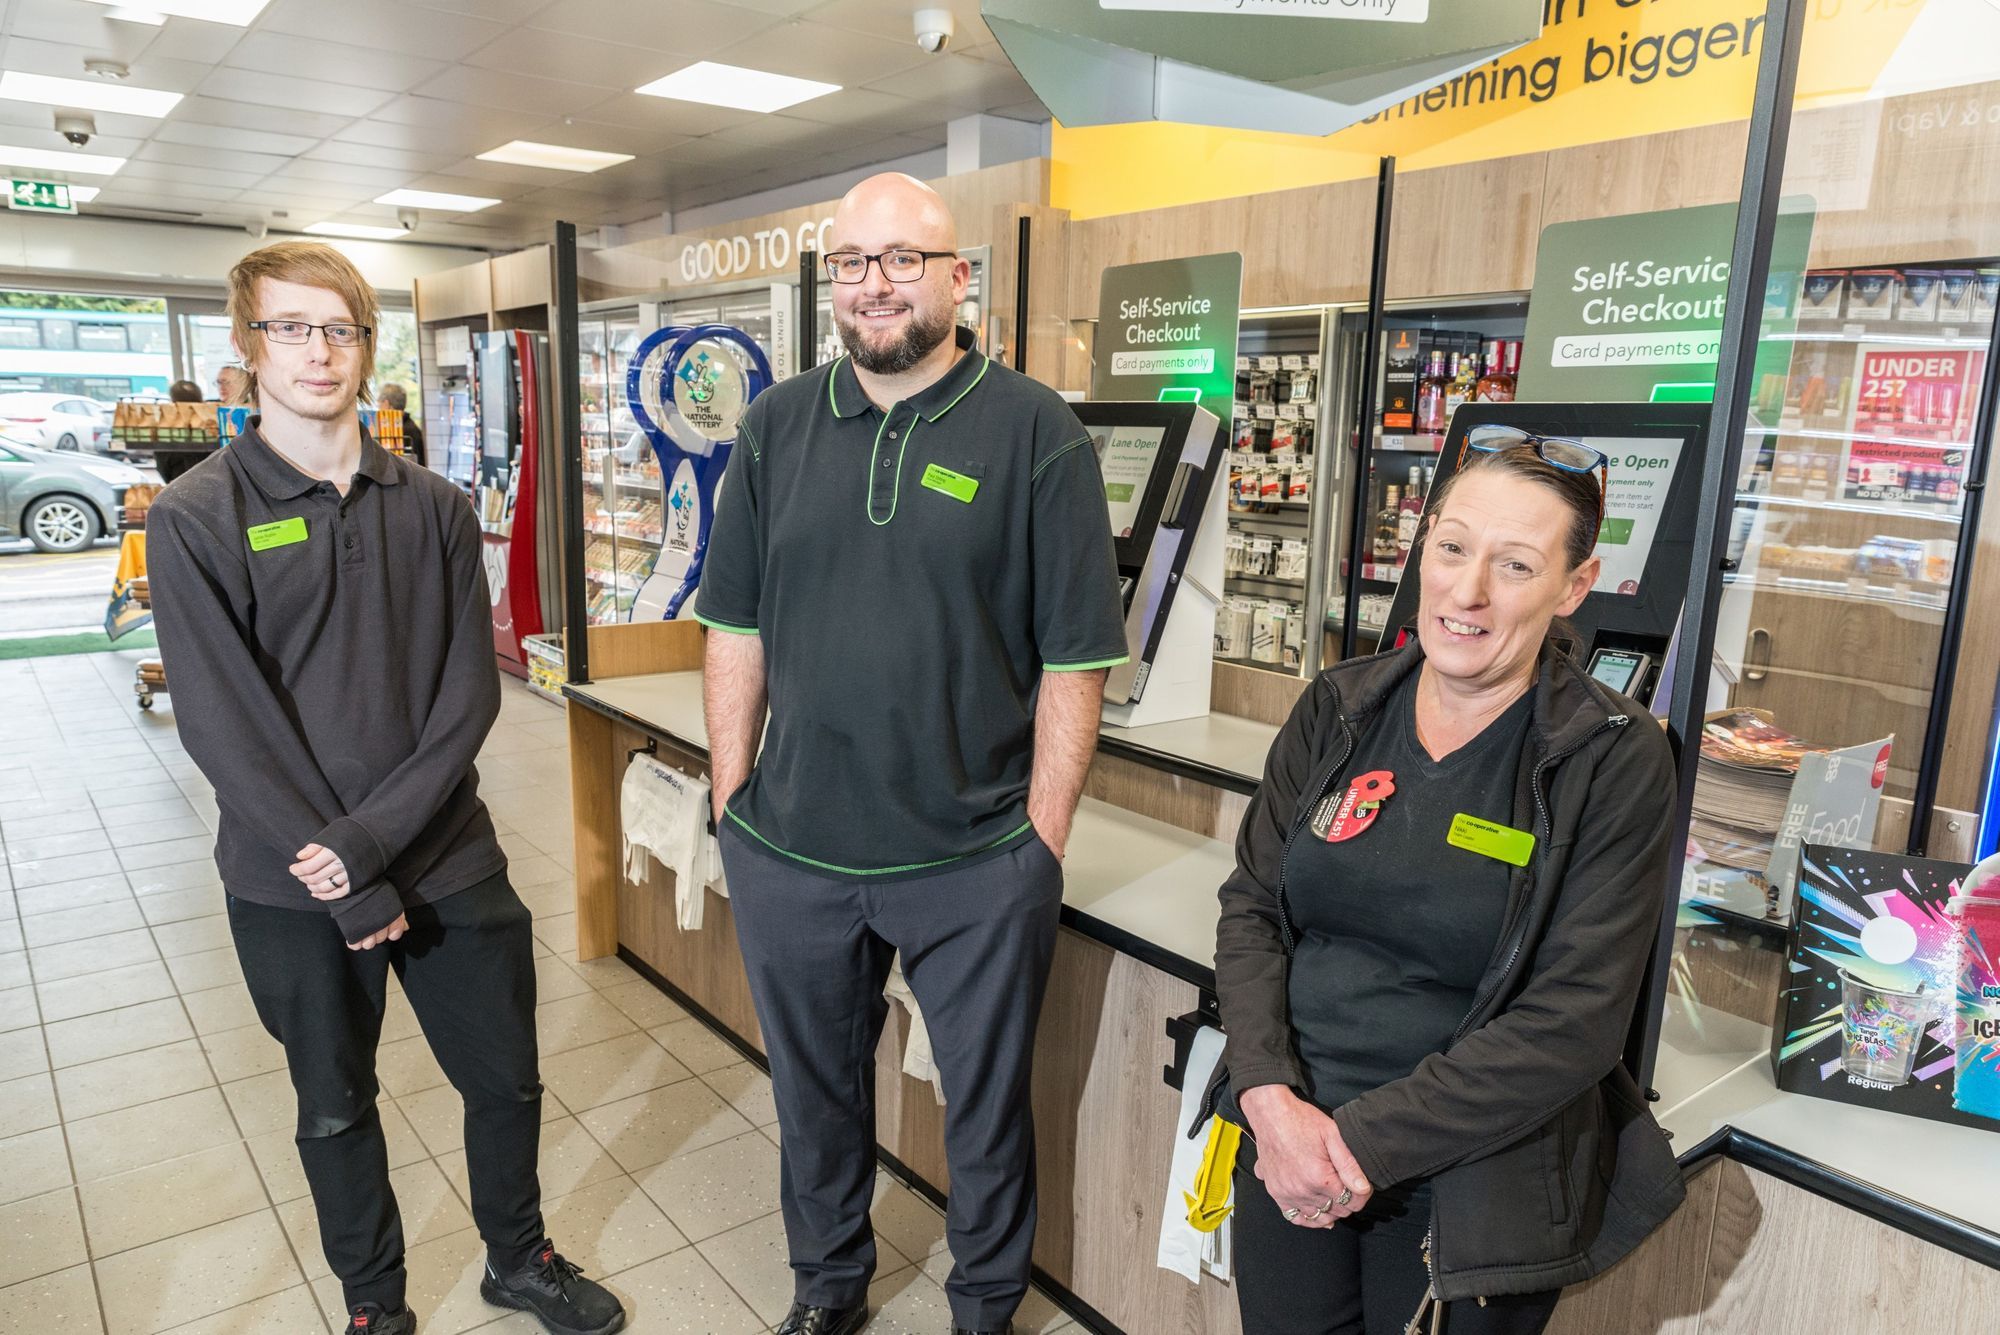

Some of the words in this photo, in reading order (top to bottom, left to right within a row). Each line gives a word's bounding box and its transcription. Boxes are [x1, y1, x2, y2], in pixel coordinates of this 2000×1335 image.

[1583, 14, 1767, 84] bigger
[680, 235, 751, 282] GOOD
[754, 227, 790, 270] TO
[1571, 256, 1731, 292] Self-Servic
[1119, 295, 1211, 320] Self-Service
[1582, 294, 1726, 325] Checkout
[776, 311, 785, 349] DRINKS
[1126, 322, 1201, 344] Checkout
[1561, 341, 1600, 359] Card
[1605, 340, 1691, 362] payments
[1697, 342, 1720, 355] on
[1116, 357, 1137, 369] Card
[1139, 358, 1185, 372] payments
[1187, 355, 1209, 370] only
[1867, 358, 1957, 378] UNDER
[1863, 379, 1908, 398] 25?
[692, 421, 721, 429] OTTERY
[1111, 438, 1132, 449] Lane
[1134, 439, 1157, 450] Open
[1625, 455, 1669, 471] Open
[1855, 449, 1900, 458] restricted
[1902, 450, 1940, 459] product
[1607, 479, 1636, 487] ayment
[1638, 480, 1655, 488] only
[1338, 788, 1359, 820] UNDER
[1331, 820, 1345, 837] 25?
[1780, 803, 1809, 849] FREE
[1860, 1027, 1878, 1038] Tango
[1864, 1036, 1887, 1047] BLAST
[1847, 1075, 1895, 1092] Regular
